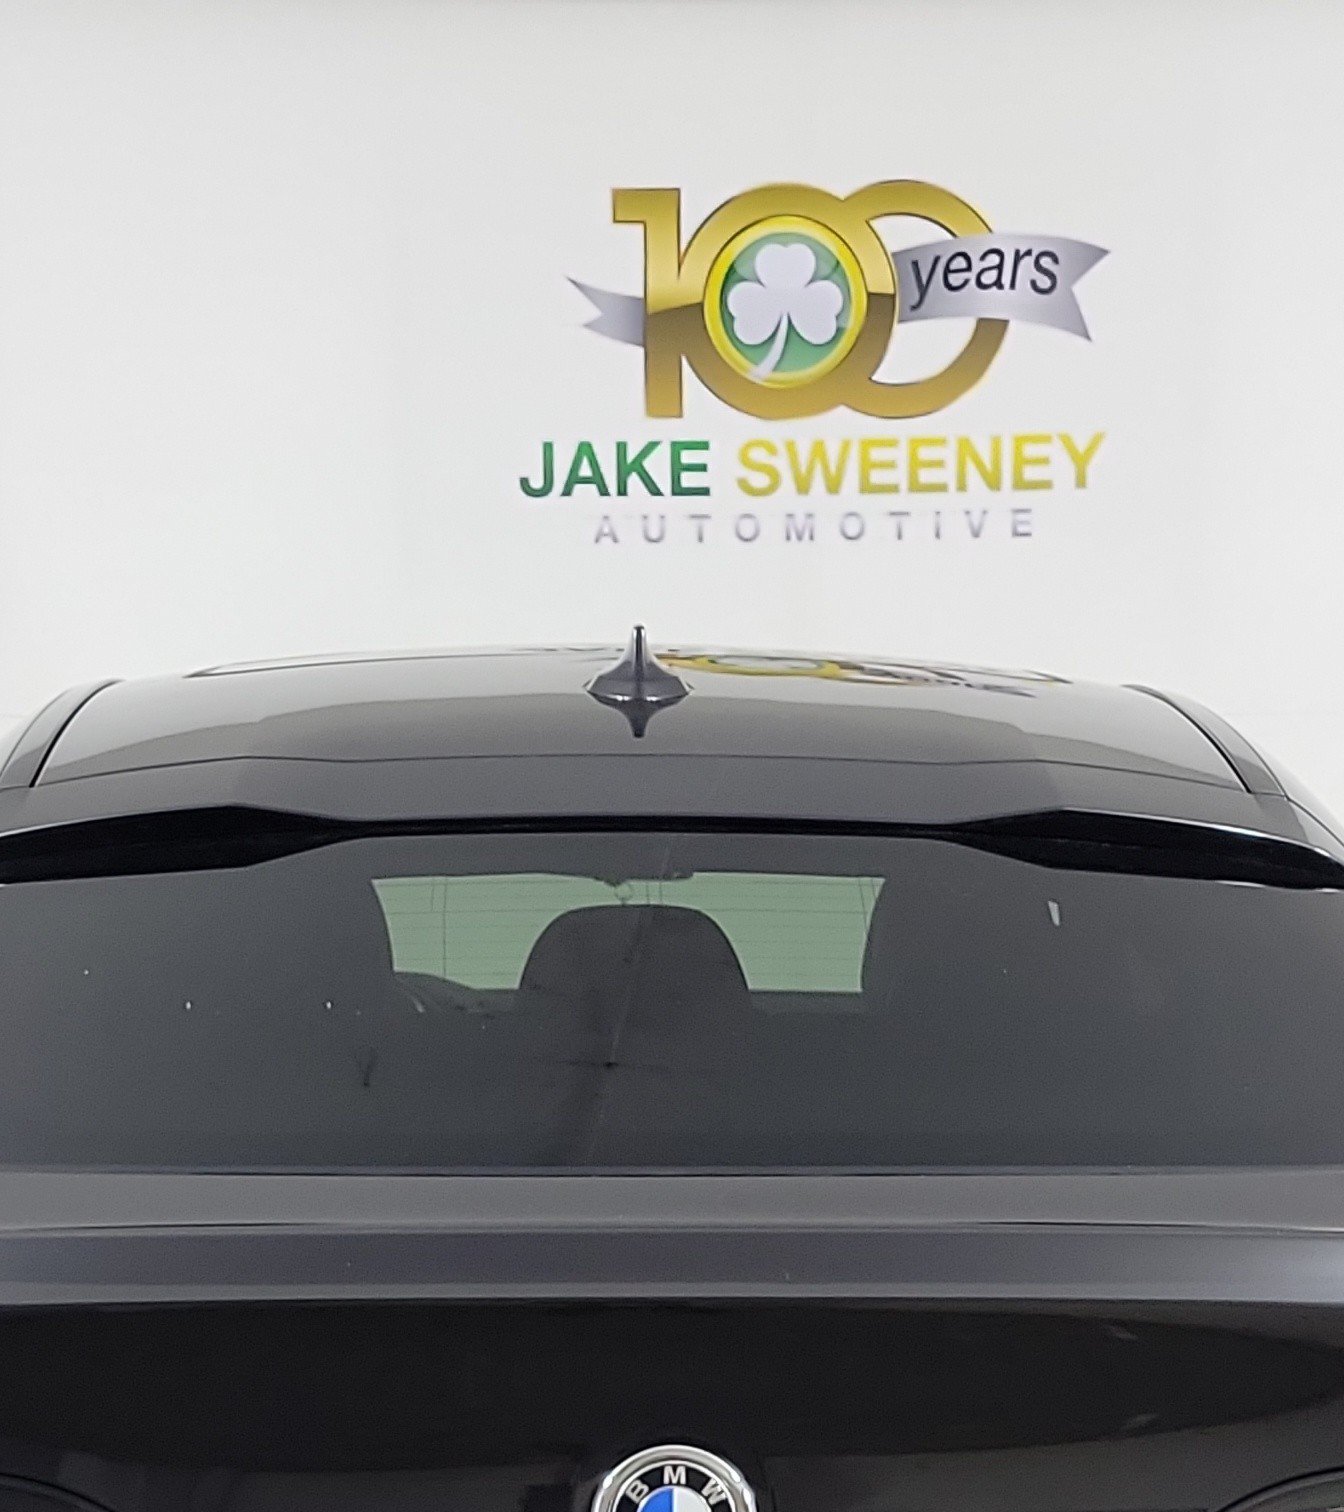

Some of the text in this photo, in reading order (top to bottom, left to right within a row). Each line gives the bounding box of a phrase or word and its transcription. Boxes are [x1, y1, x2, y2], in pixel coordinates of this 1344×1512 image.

[910, 247, 1061, 311] years
[519, 432, 1106, 498] JAKE SWEENEY
[593, 507, 1034, 545] AUTOMOTIVE
[624, 1465, 729, 1506] BMW
